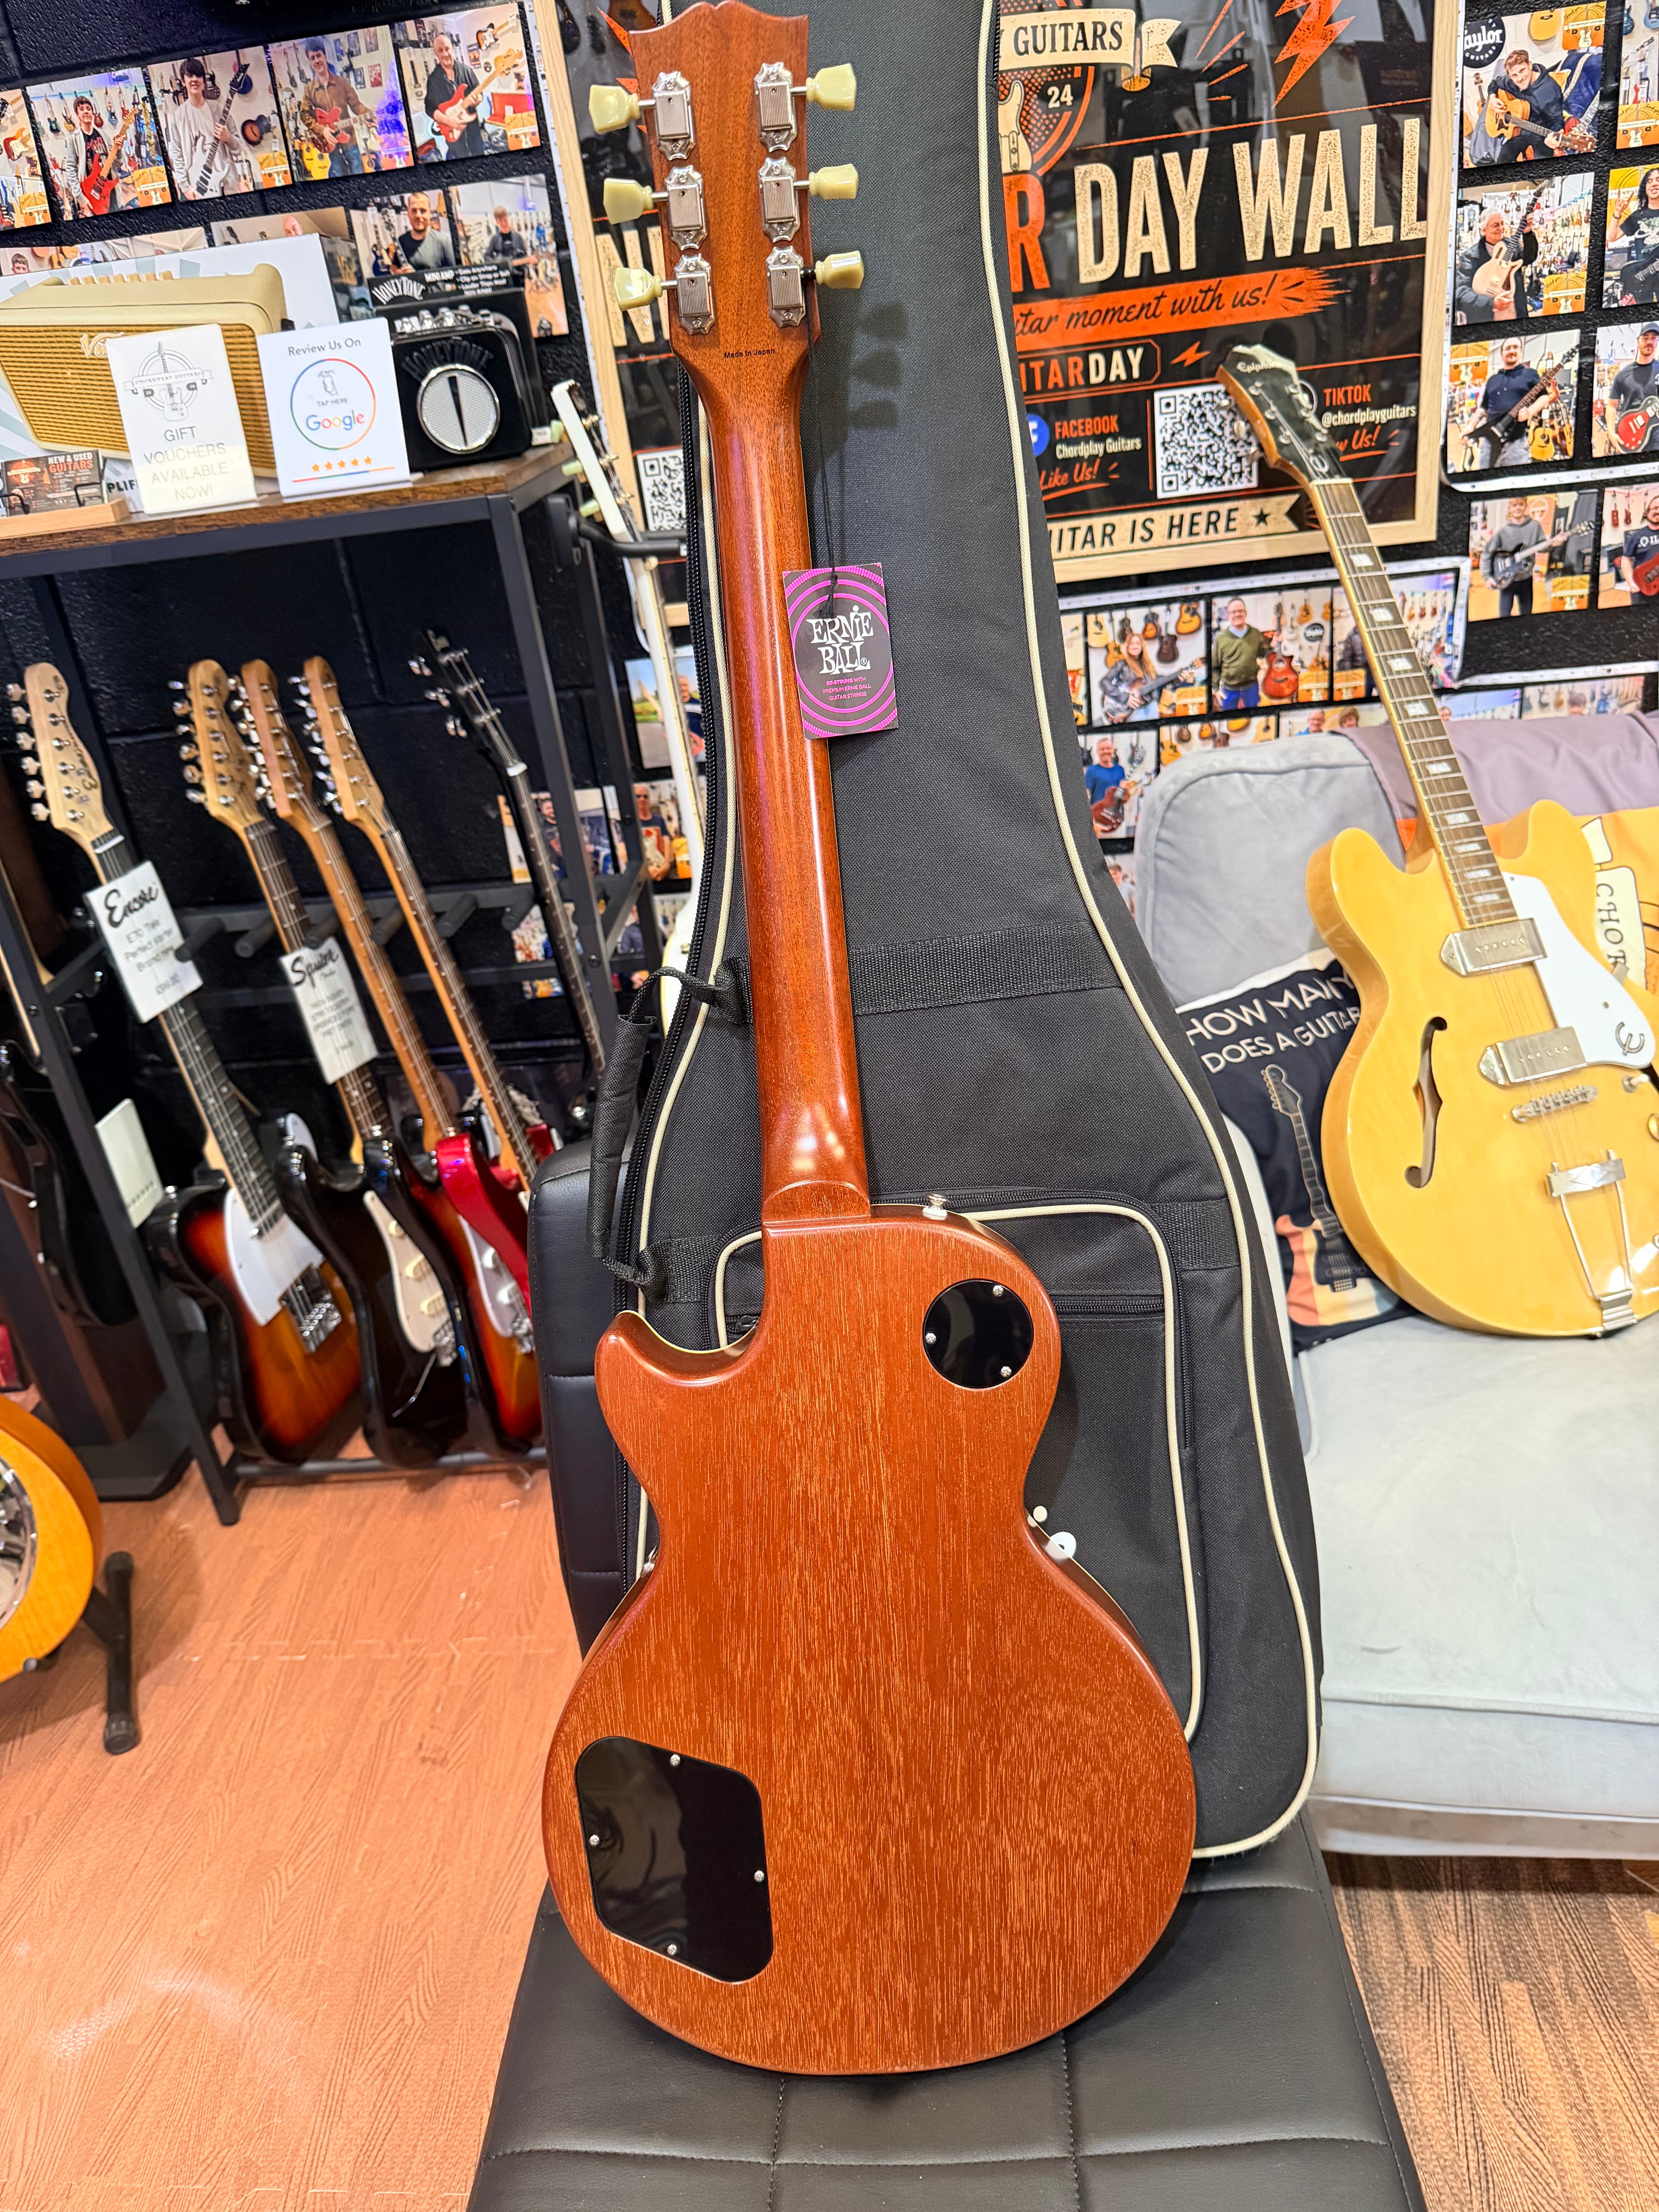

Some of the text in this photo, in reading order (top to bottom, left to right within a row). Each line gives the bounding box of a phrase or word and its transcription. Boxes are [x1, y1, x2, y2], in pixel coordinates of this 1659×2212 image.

[1013, 20, 1122, 57] GUITARS
[1048, 84, 1073, 108] 24
[1074, 148, 1209, 285] DAY
[1233, 118, 1427, 261] WALL
[372, 276, 426, 305] HONEYTONE
[1066, 292, 1167, 330] moment
[1170, 280, 1225, 316] with
[1232, 273, 1278, 307] us!
[288, 338, 361, 356] Review Us On
[1323, 384, 1371, 407] TIKTOK
[306, 409, 365, 431] Google
[1055, 415, 1119, 440] FACEBOOK
[1321, 404, 1417, 429] @chordplayguitars
[164, 426, 196, 442] GIFT
[1352, 424, 1381, 450] Us!
[48, 452, 93, 465] NEW & USED
[143, 442, 227, 464] VOUCHERS
[1056, 436, 1142, 460] Chordplay Guitars
[49, 460, 93, 473] GUITARS
[151, 462, 229, 485] AVAILABLE
[1039, 458, 1101, 491] Like Us!
[174, 485, 213, 502] NOW!
[1129, 518, 1155, 544] IS
[1167, 508, 1239, 540] HERE
[104, 885, 159, 928] Encore
[291, 949, 339, 989] Squier
[1185, 998, 1267, 1046] HOW
[1201, 1006, 1360, 1074] DOES A GUITAR
